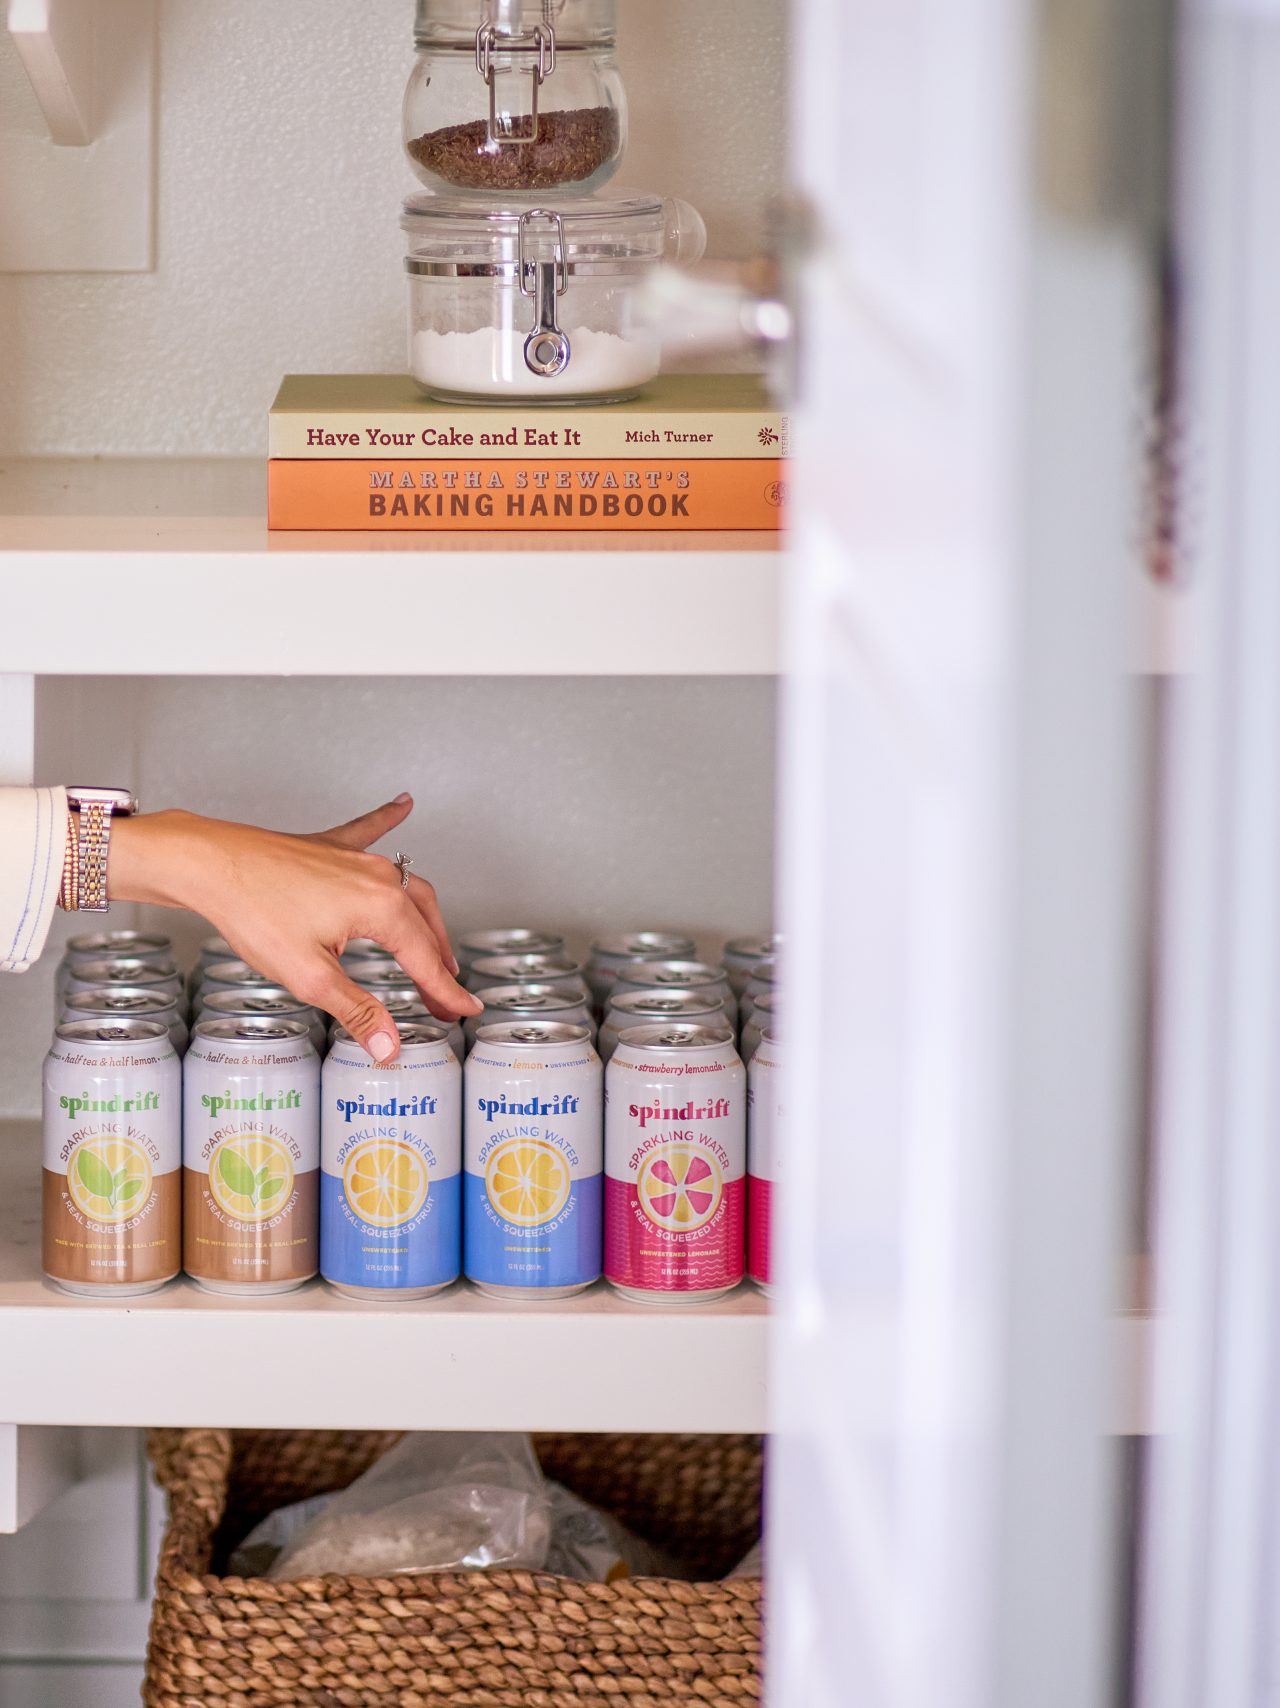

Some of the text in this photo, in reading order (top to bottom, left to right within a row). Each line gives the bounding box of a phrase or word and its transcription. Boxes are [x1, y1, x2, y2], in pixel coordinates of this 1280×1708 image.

[306, 427, 581, 446] Have Your Cake and Eat It
[625, 430, 713, 443] Mich Turner
[369, 471, 690, 489] MARTHA STEWART'S
[369, 494, 690, 517] BAKING HANDBOOK
[64, 1053, 84, 1065] half
[99, 1058, 108, 1067] &
[109, 1056, 129, 1067] half
[131, 1056, 158, 1066] lemon
[205, 1052, 224, 1063] half
[224, 1056, 240, 1064] tea
[241, 1056, 250, 1065] &
[251, 1054, 271, 1065] half
[272, 1055, 298, 1064] lemon
[512, 1058, 543, 1070] lemon
[638, 1063, 683, 1076] strawberry
[684, 1061, 722, 1074] lemonade
[59, 1091, 160, 1119] spindrift
[201, 1089, 302, 1118] spindrift
[336, 1094, 437, 1123] spindrift
[477, 1094, 579, 1122] spindrift
[628, 1098, 730, 1128] spindrift
[60, 1123, 160, 1162] SPARKLING WATER
[201, 1121, 302, 1161] SPARKLING WATER
[336, 1127, 437, 1167] SPARKLING WATER
[478, 1126, 579, 1166] SPARKLING WATER
[628, 1130, 730, 1171] SPARKLING WATER
[61, 1191, 159, 1234] & REAL SQUEEZED FRUIT
[202, 1190, 300, 1233] & REAL SQUEEZED FRUIT
[341, 1203, 359, 1228] REAL
[360, 1222, 416, 1239] SQUEEZED
[416, 1196, 435, 1224] FRUIT
[479, 1194, 577, 1238] & REAL SQUEEZED FRUIT
[630, 1198, 728, 1242] & REAL SQUEEZED FRUIT
[639, 1249, 720, 1258] UNSWEETENED LEMONADE
